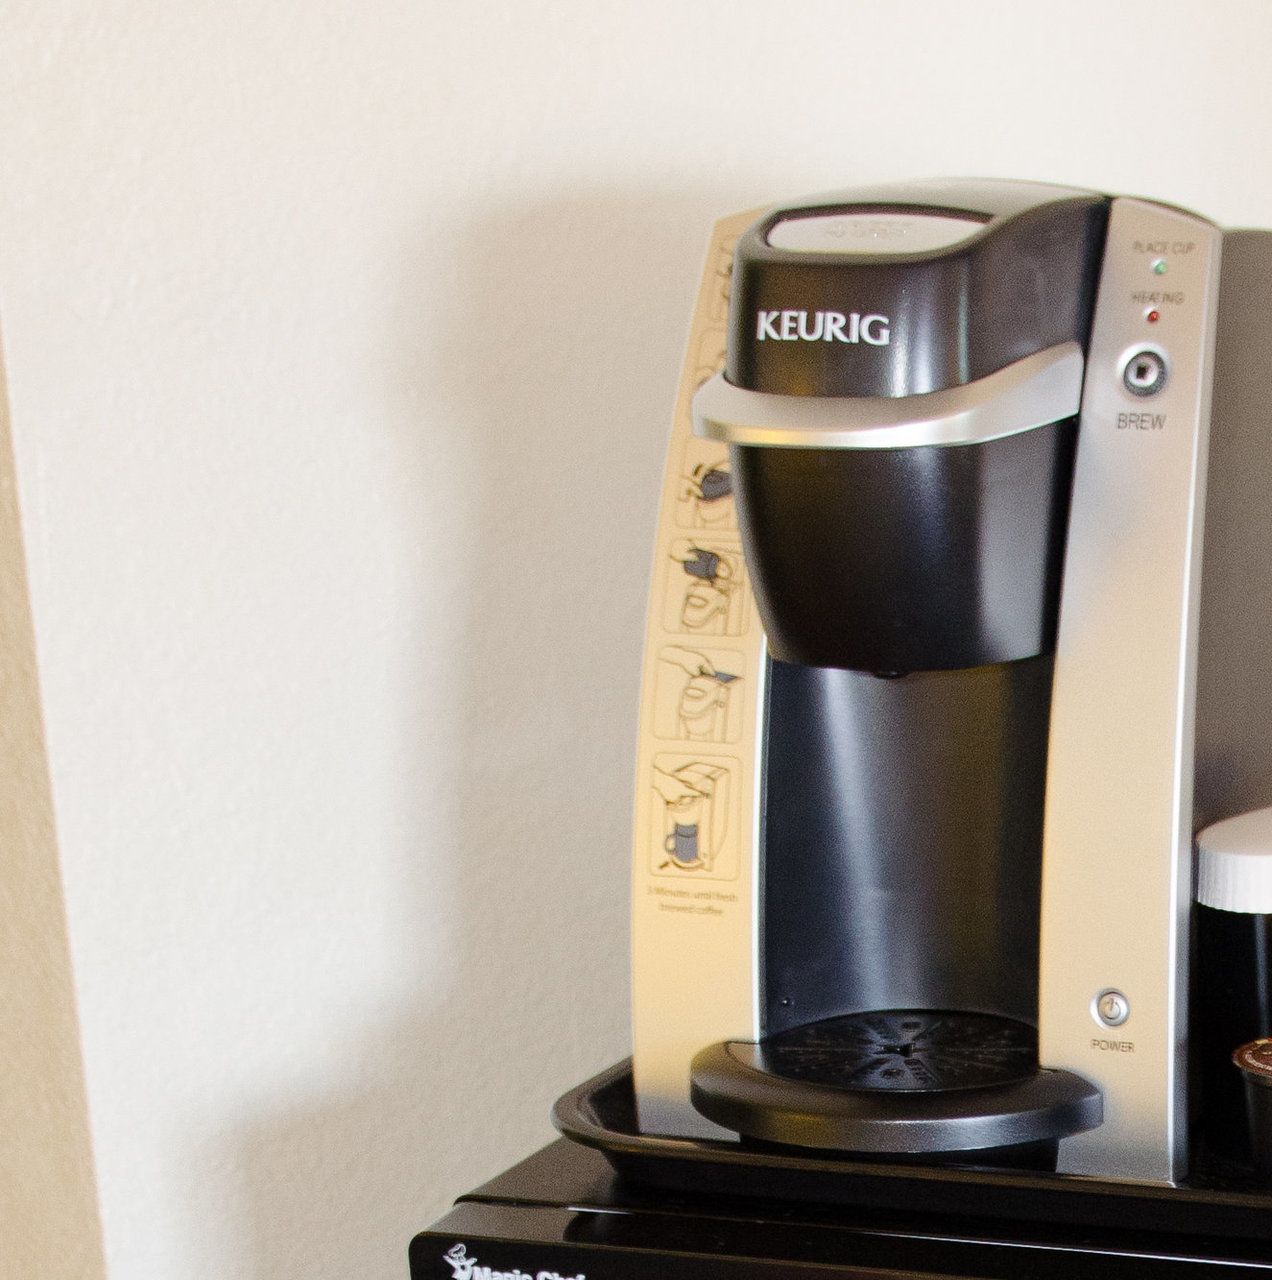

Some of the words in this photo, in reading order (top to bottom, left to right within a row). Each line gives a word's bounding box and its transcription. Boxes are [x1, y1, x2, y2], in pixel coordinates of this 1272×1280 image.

[756, 310, 891, 346] KEURIG
[1117, 412, 1167, 430] BREW
[1091, 1039, 1135, 1053] POWER
